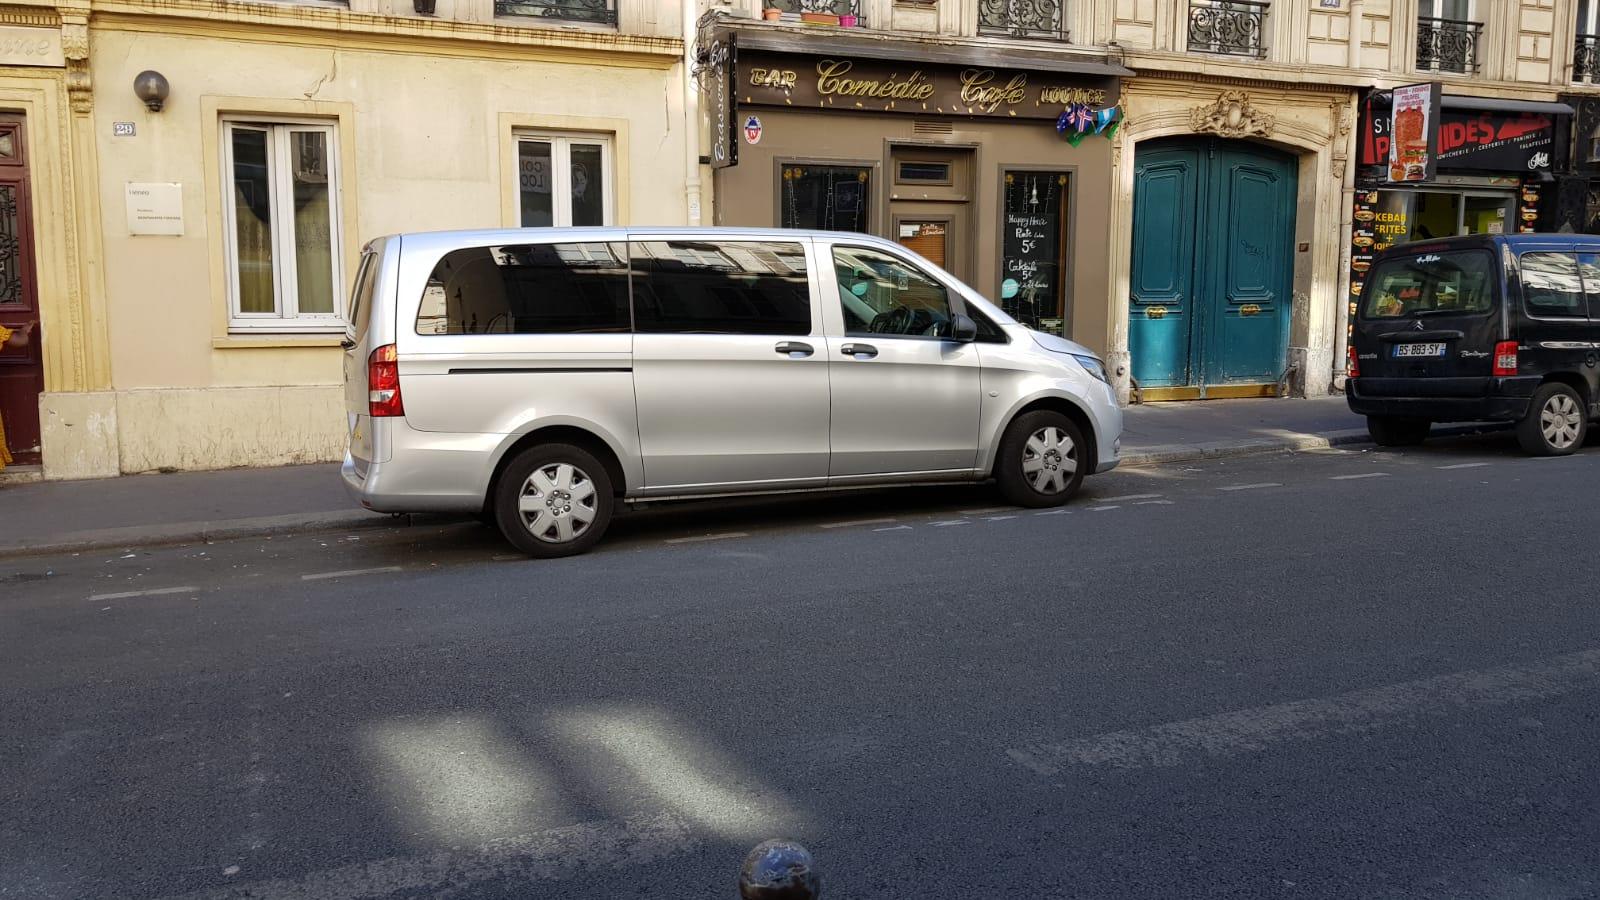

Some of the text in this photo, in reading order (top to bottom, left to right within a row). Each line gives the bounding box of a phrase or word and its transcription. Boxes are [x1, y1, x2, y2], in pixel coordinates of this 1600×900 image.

[750, 68, 797, 88] BAR
[116, 124, 134, 134] 29
[1375, 212, 1407, 222] KEBAB
[1375, 224, 1407, 234] FRITES
